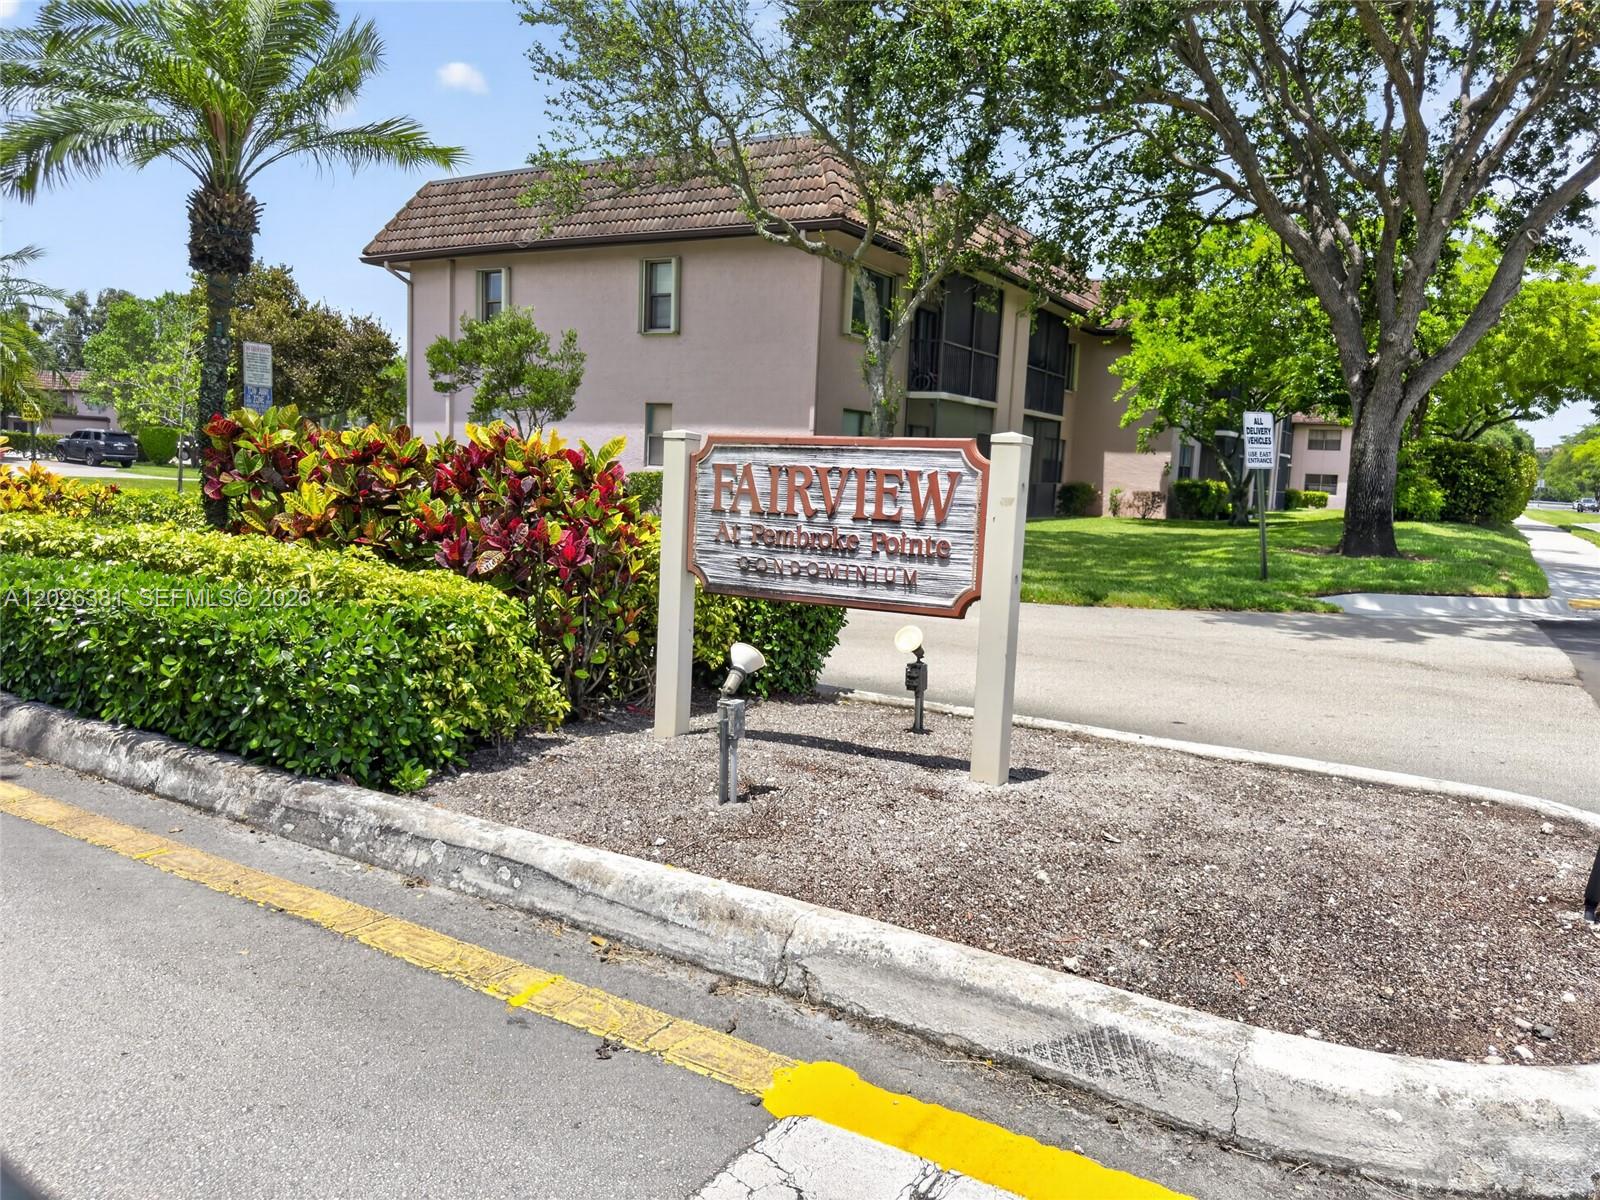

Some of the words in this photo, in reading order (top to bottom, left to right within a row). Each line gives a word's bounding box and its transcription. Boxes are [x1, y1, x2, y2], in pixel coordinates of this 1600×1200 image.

[1246, 427, 1271, 435] DELIVERY
[711, 462, 961, 527] FAIRVIEW
[716, 521, 741, 545] At
[751, 523, 860, 552] Pembroke
[871, 530, 951, 558] Pointe
[738, 556, 919, 586] CONDOMINIUM
